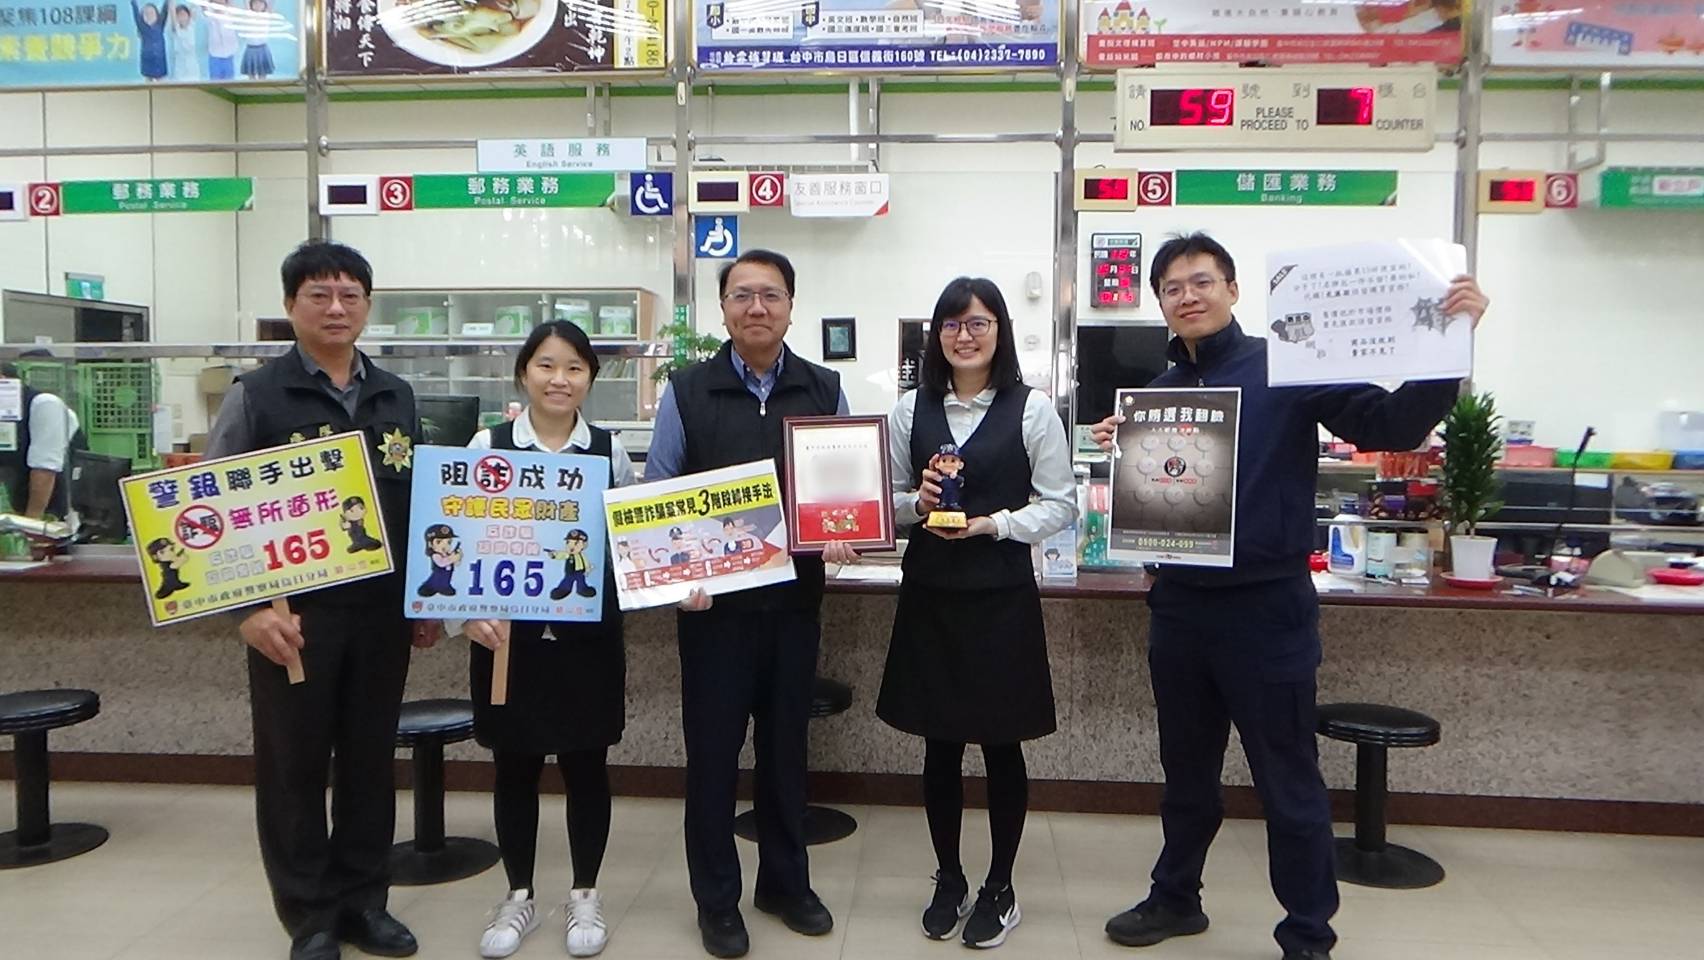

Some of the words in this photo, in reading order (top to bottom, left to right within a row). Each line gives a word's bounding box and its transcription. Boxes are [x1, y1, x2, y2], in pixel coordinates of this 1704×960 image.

[1242, 84, 1261, 99] 號
[1292, 84, 1311, 99] 到
[1179, 89, 1234, 125] 59
[1256, 107, 1294, 118] PLEASE
[1351, 88, 1374, 124] 7
[1240, 120, 1288, 131] PROCEED
[1295, 120, 1309, 131] TO
[1376, 119, 1424, 130] COUNTER
[513, 143, 611, 157] 英語服務
[561, 160, 593, 168] Service
[112, 181, 200, 200] 郵務業務
[387, 183, 405, 204] 3
[467, 176, 560, 195] 郵務業務
[756, 177, 775, 201] 4
[794, 180, 882, 197] 友善服務窗口
[1144, 177, 1164, 201] 5
[1236, 173, 1338, 192] 儲匯業務
[1549, 179, 1570, 203] 6
[34, 188, 54, 211] 2
[474, 197, 505, 206] Postal
[510, 196, 546, 206] Service
[1260, 193, 1303, 203] Banking
[148, 448, 345, 509] 警銀聯手出擊
[440, 460, 584, 491] 阻詐成功
[228, 488, 340, 530] 無所遁形
[441, 495, 580, 522] 守護民眾財產
[262, 528, 331, 571] 165
[467, 558, 545, 597] 165
